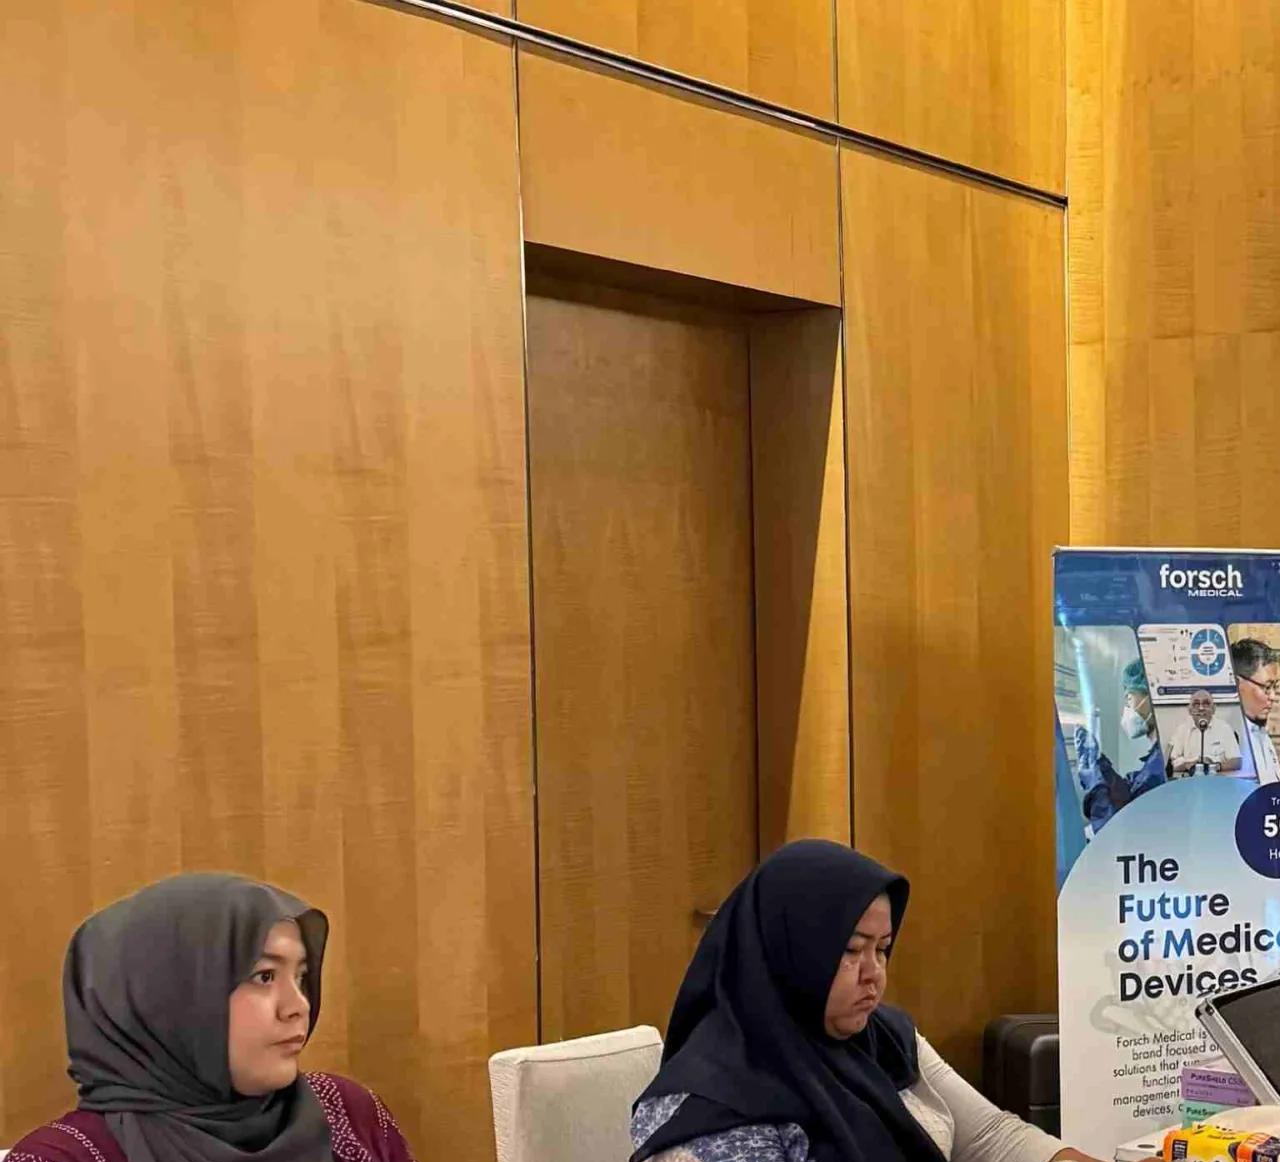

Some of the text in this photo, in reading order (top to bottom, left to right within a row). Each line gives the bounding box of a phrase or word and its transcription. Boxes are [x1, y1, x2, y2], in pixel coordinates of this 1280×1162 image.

[1160, 564, 1243, 589] forsch
[1188, 589, 1243, 597] MEDICAL
[1116, 853, 1179, 885] The
[1118, 893, 1229, 924] Future
[1118, 933, 1154, 963] of
[1120, 965, 1258, 1002] Devices
[1116, 1028, 1207, 1048] Forsch Medical is
[1132, 1046, 1162, 1061] brand
[1166, 1041, 1206, 1056] focused
[1113, 1064, 1157, 1077] solutions
[1160, 1060, 1180, 1071] that
[1113, 1089, 1180, 1106] management
[1133, 1104, 1174, 1118] devices,
